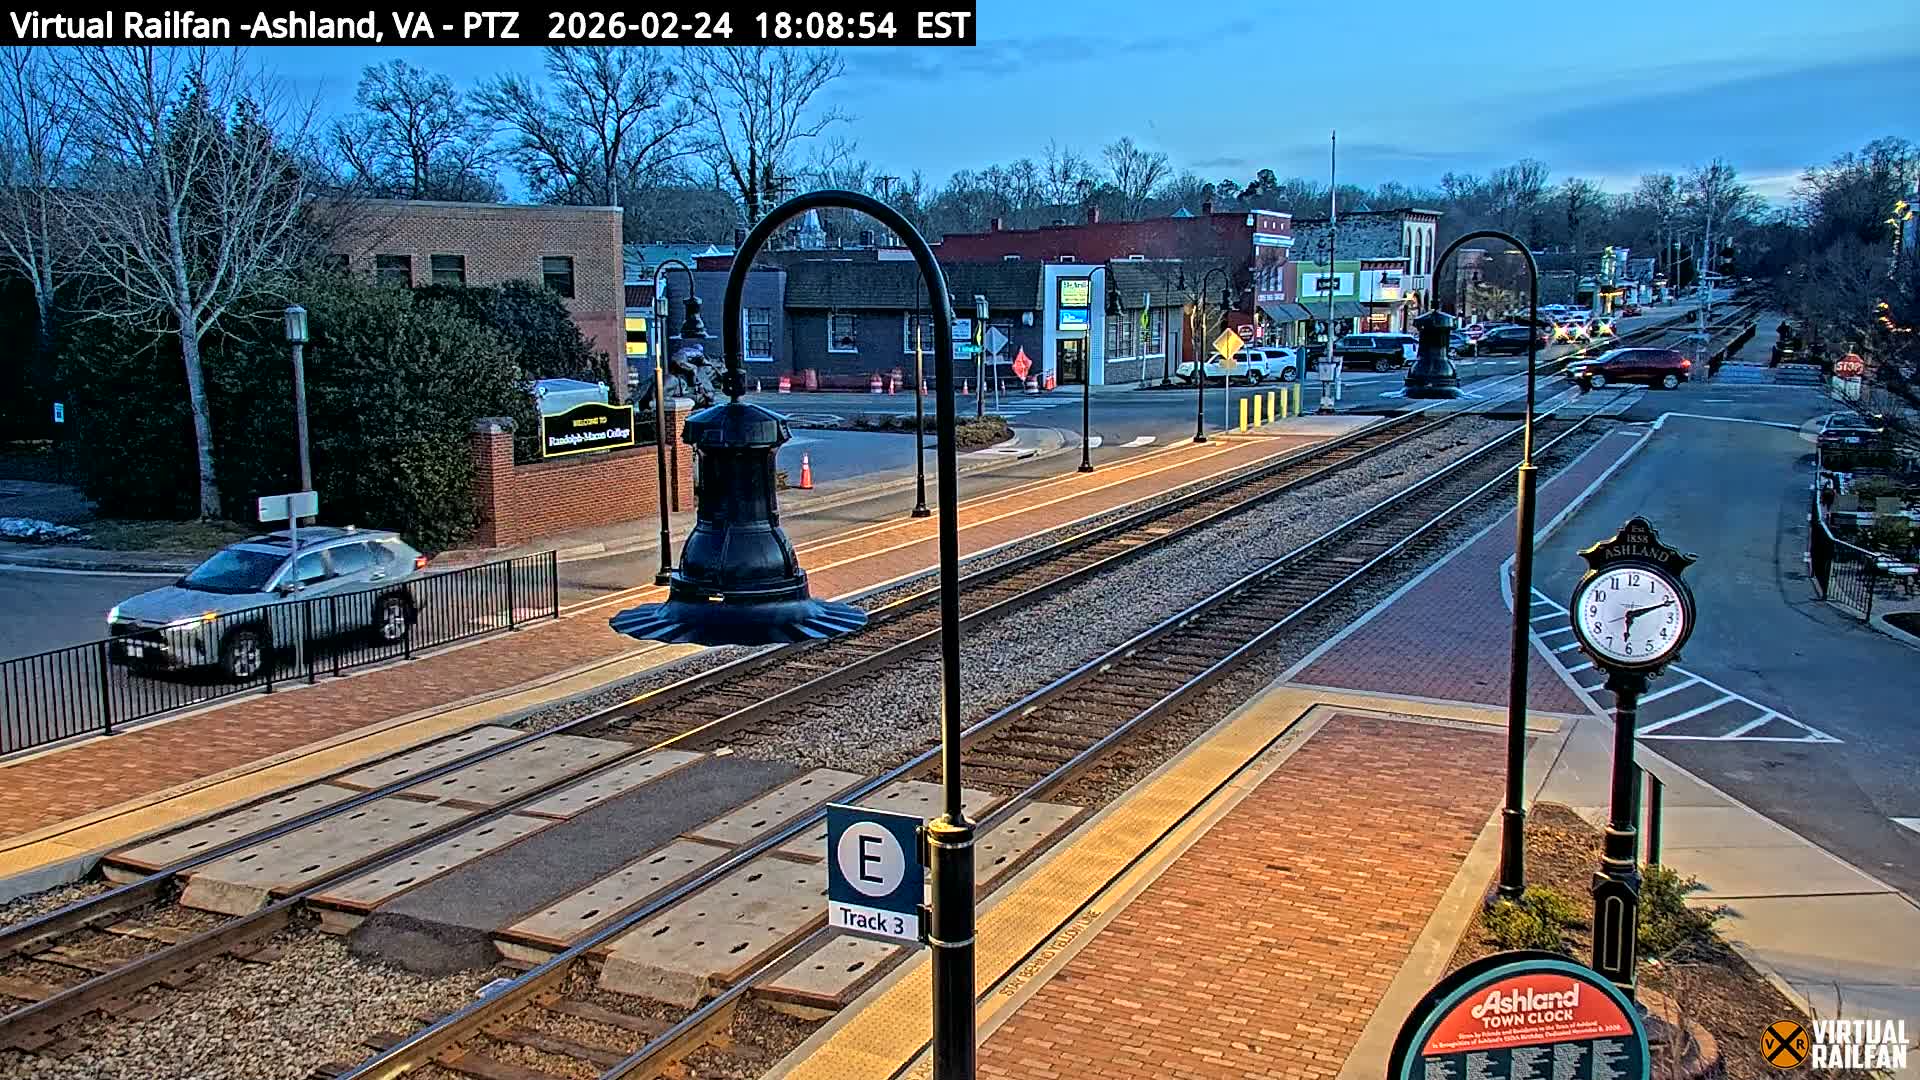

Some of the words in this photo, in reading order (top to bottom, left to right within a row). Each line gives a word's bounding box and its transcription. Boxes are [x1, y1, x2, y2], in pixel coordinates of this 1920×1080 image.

[1836, 361, 1861, 371] STOP
[599, 416, 607, 424] TO
[549, 431, 606, 446] Randolph-Macon
[607, 428, 630, 439] College
[1627, 534, 1649, 544] 1858
[1605, 545, 1670, 562] ASHLAND
[1611, 578, 1619, 590] 11
[1628, 574, 1640, 587] 12
[1650, 581, 1655, 593] 1
[1595, 590, 1606, 602] 10
[1590, 605, 1597, 618] 9
[1666, 612, 1674, 624] 3
[1593, 622, 1602, 634] 8
[1660, 628, 1667, 640] 4
[1606, 636, 1613, 648] 7
[1645, 640, 1654, 652] 5
[1626, 642, 1633, 655] 6
[859, 835, 883, 884] E
[840, 907, 887, 932] Track
[894, 917, 904, 934] 3
[1471, 983, 1580, 1019] Ashland
[1482, 1012, 1525, 1029] TOWN
[1527, 1009, 1574, 1025] CLOCK
